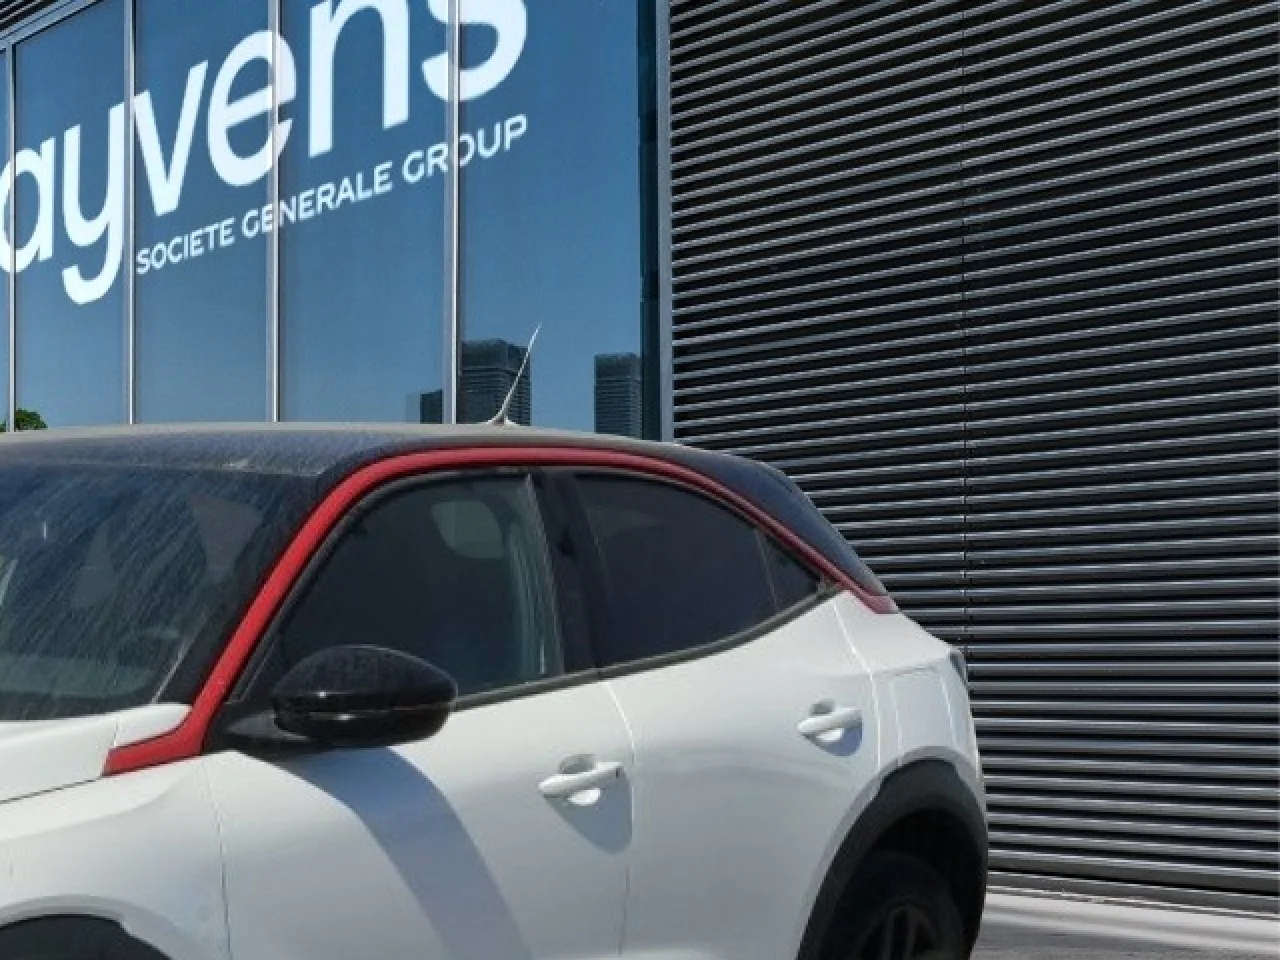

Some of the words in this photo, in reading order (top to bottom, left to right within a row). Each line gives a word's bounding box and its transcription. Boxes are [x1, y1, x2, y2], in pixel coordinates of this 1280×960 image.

[135, 218, 235, 275] SOCIETE
[241, 161, 394, 235] GENERALE
[402, 114, 527, 184] GROUP
